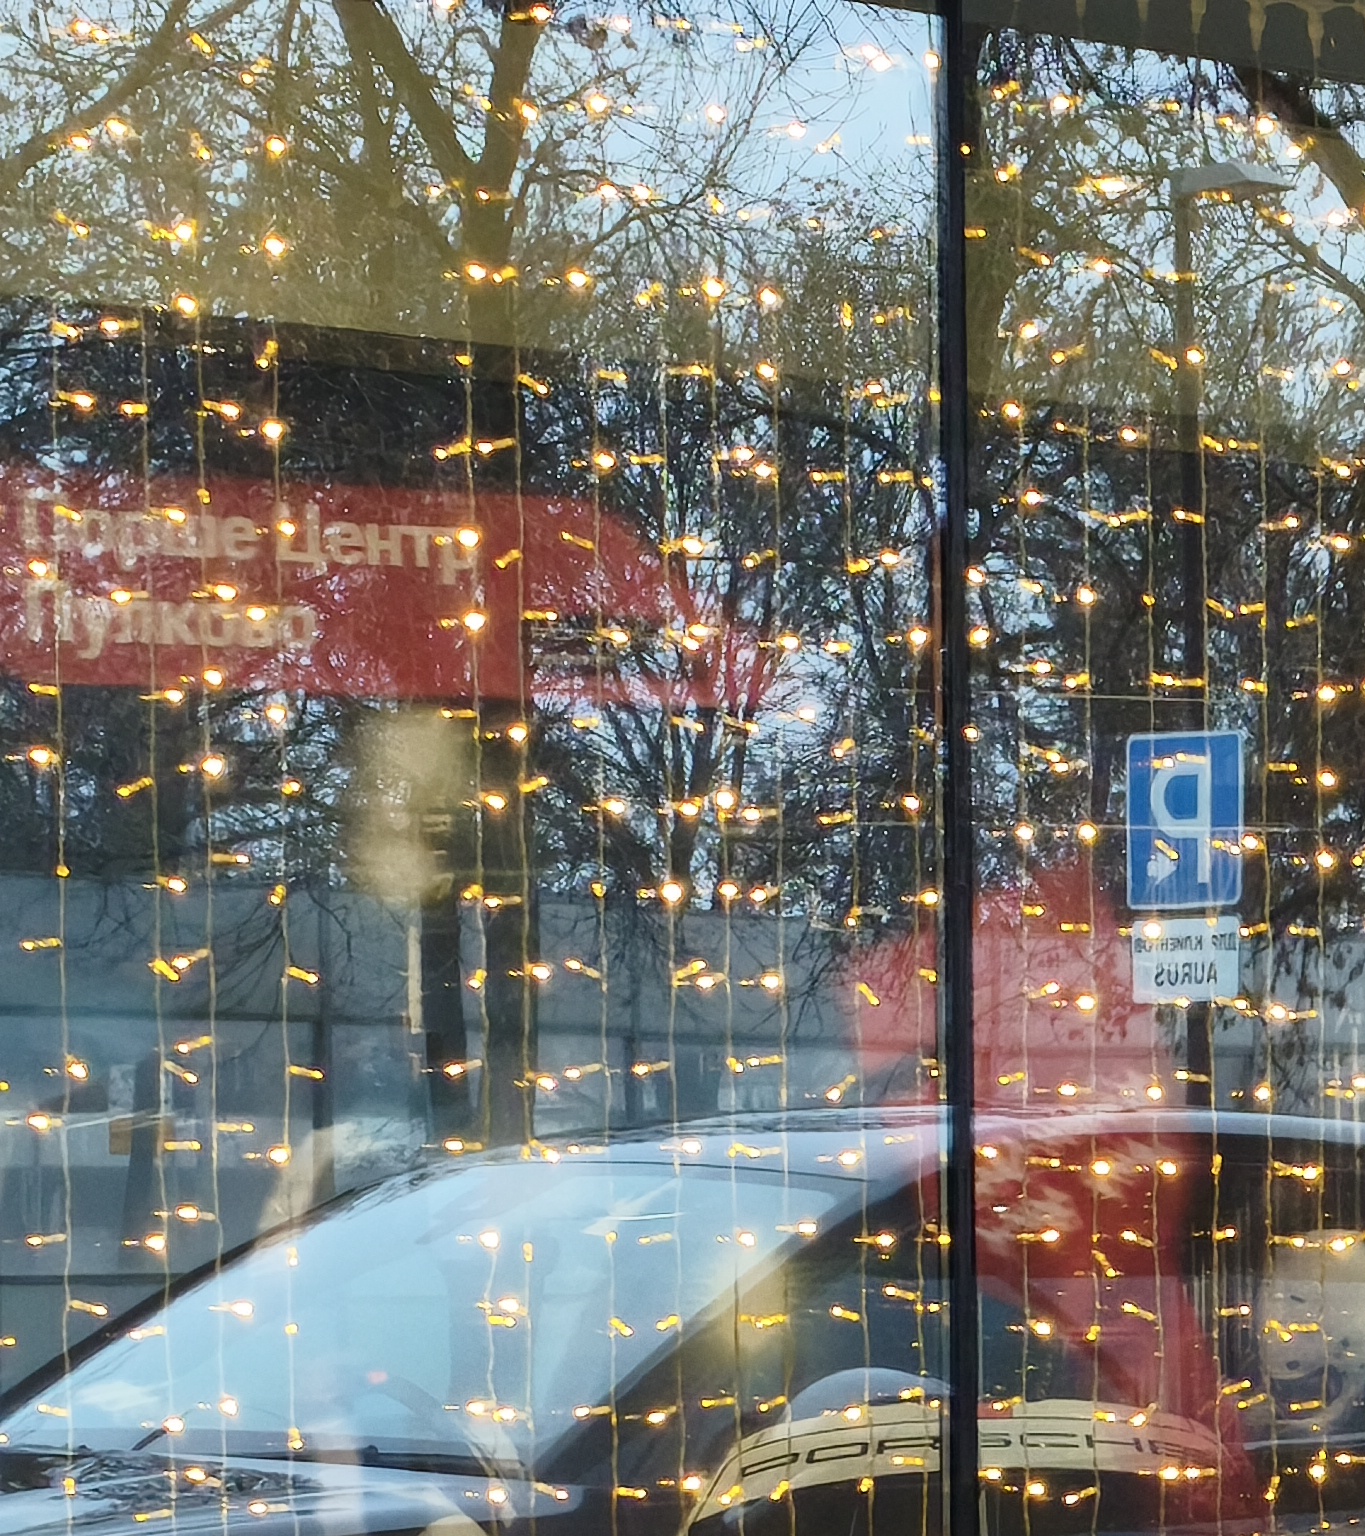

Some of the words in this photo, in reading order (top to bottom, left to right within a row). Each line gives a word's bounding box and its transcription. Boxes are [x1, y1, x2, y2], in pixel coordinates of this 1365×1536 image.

[22, 487, 261, 570] Порше
[276, 501, 477, 585] Центр
[27, 578, 319, 660] Пулково
